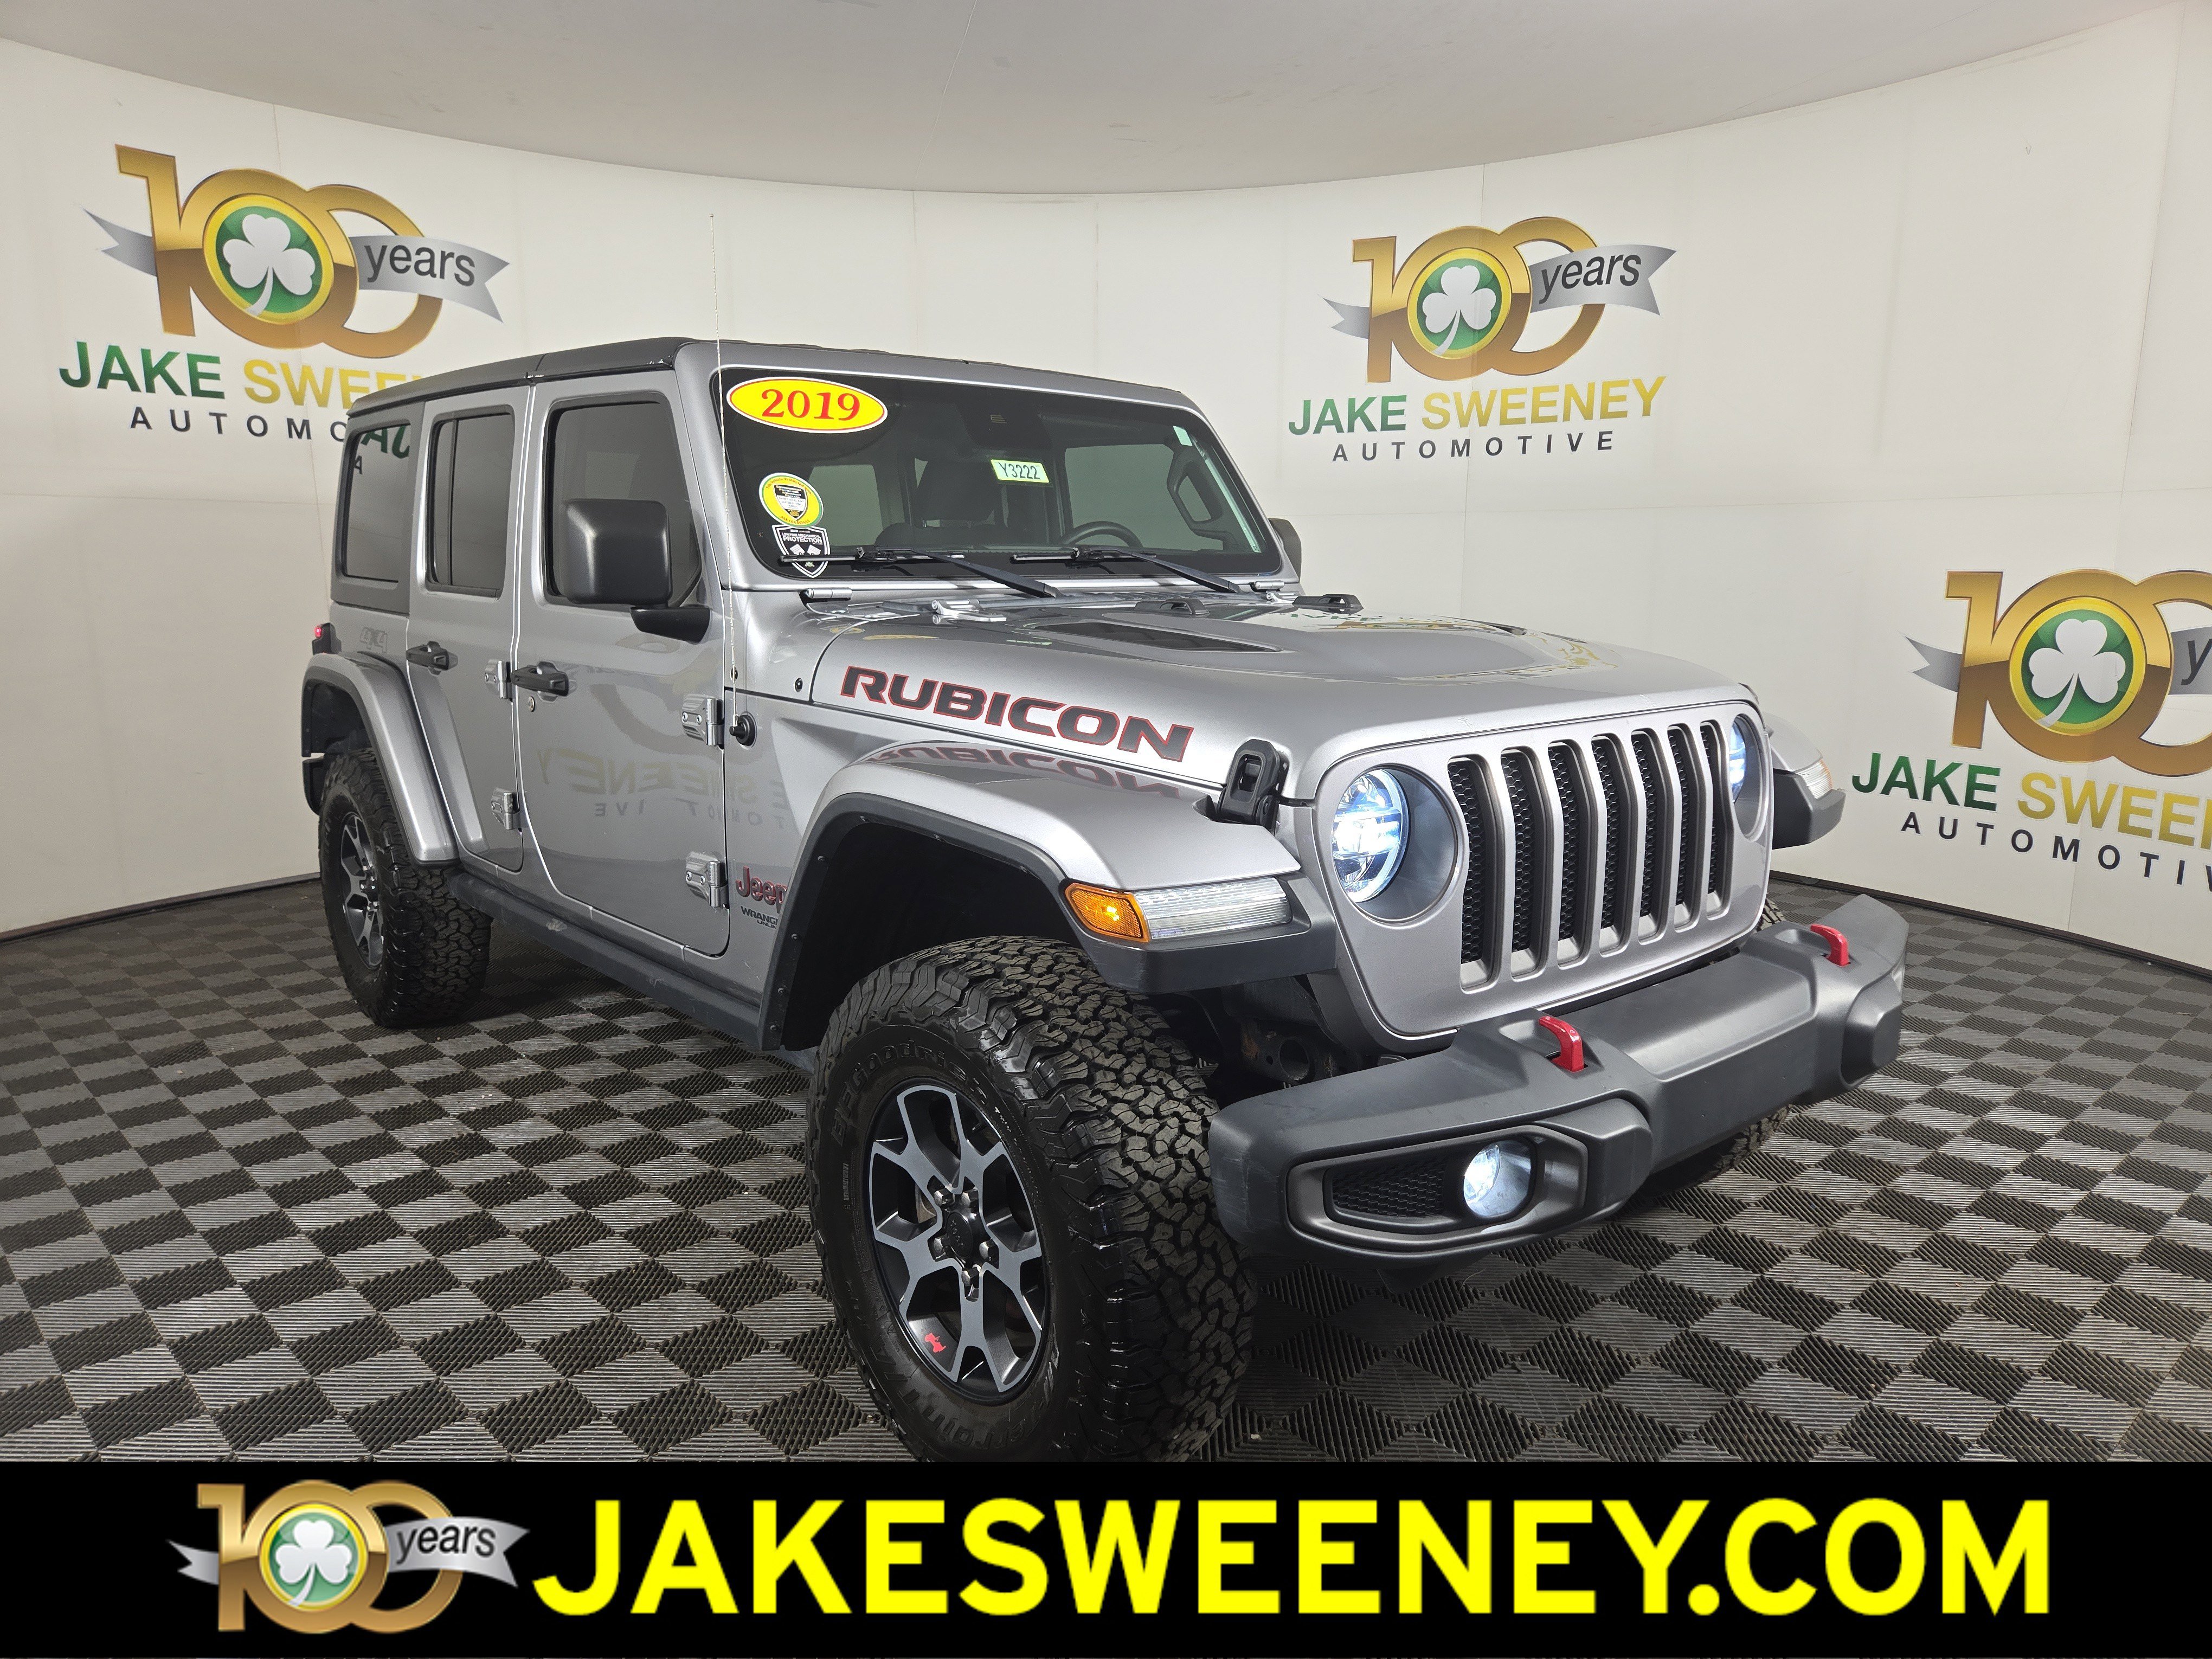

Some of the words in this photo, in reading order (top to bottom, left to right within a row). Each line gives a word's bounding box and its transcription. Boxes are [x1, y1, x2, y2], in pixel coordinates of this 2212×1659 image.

[364, 243, 476, 287] years
[1538, 253, 1642, 305] years
[59, 340, 225, 400] JAKE
[762, 388, 860, 421] 2019
[1289, 394, 1407, 436] JAKE
[1421, 375, 1667, 430] SWEENEY
[998, 462, 1040, 480] Y3222
[1332, 430, 1613, 462] AUTOMOTIVE
[840, 665, 1194, 762] RUBICON
[1851, 752, 2001, 812] JAKE
